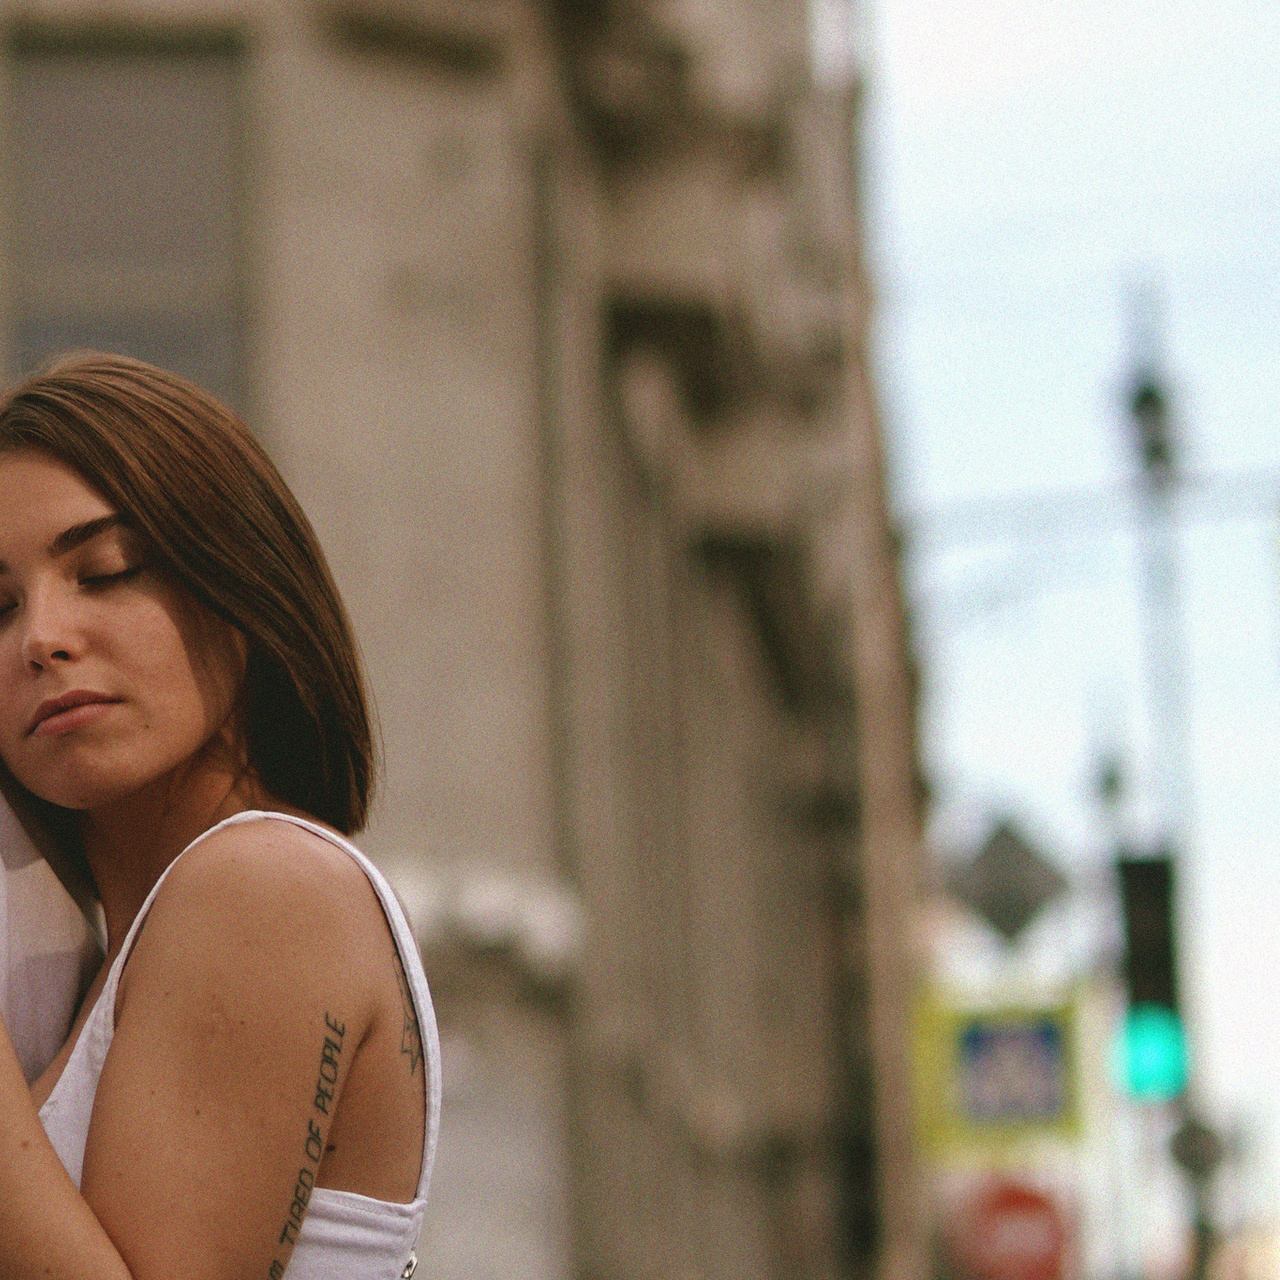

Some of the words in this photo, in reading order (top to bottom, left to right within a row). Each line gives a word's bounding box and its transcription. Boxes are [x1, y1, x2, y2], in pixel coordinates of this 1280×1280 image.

[279, 1167, 315, 1246] TIRED
[305, 1119, 322, 1163] OF
[314, 1012, 346, 1116] PEOPLE
